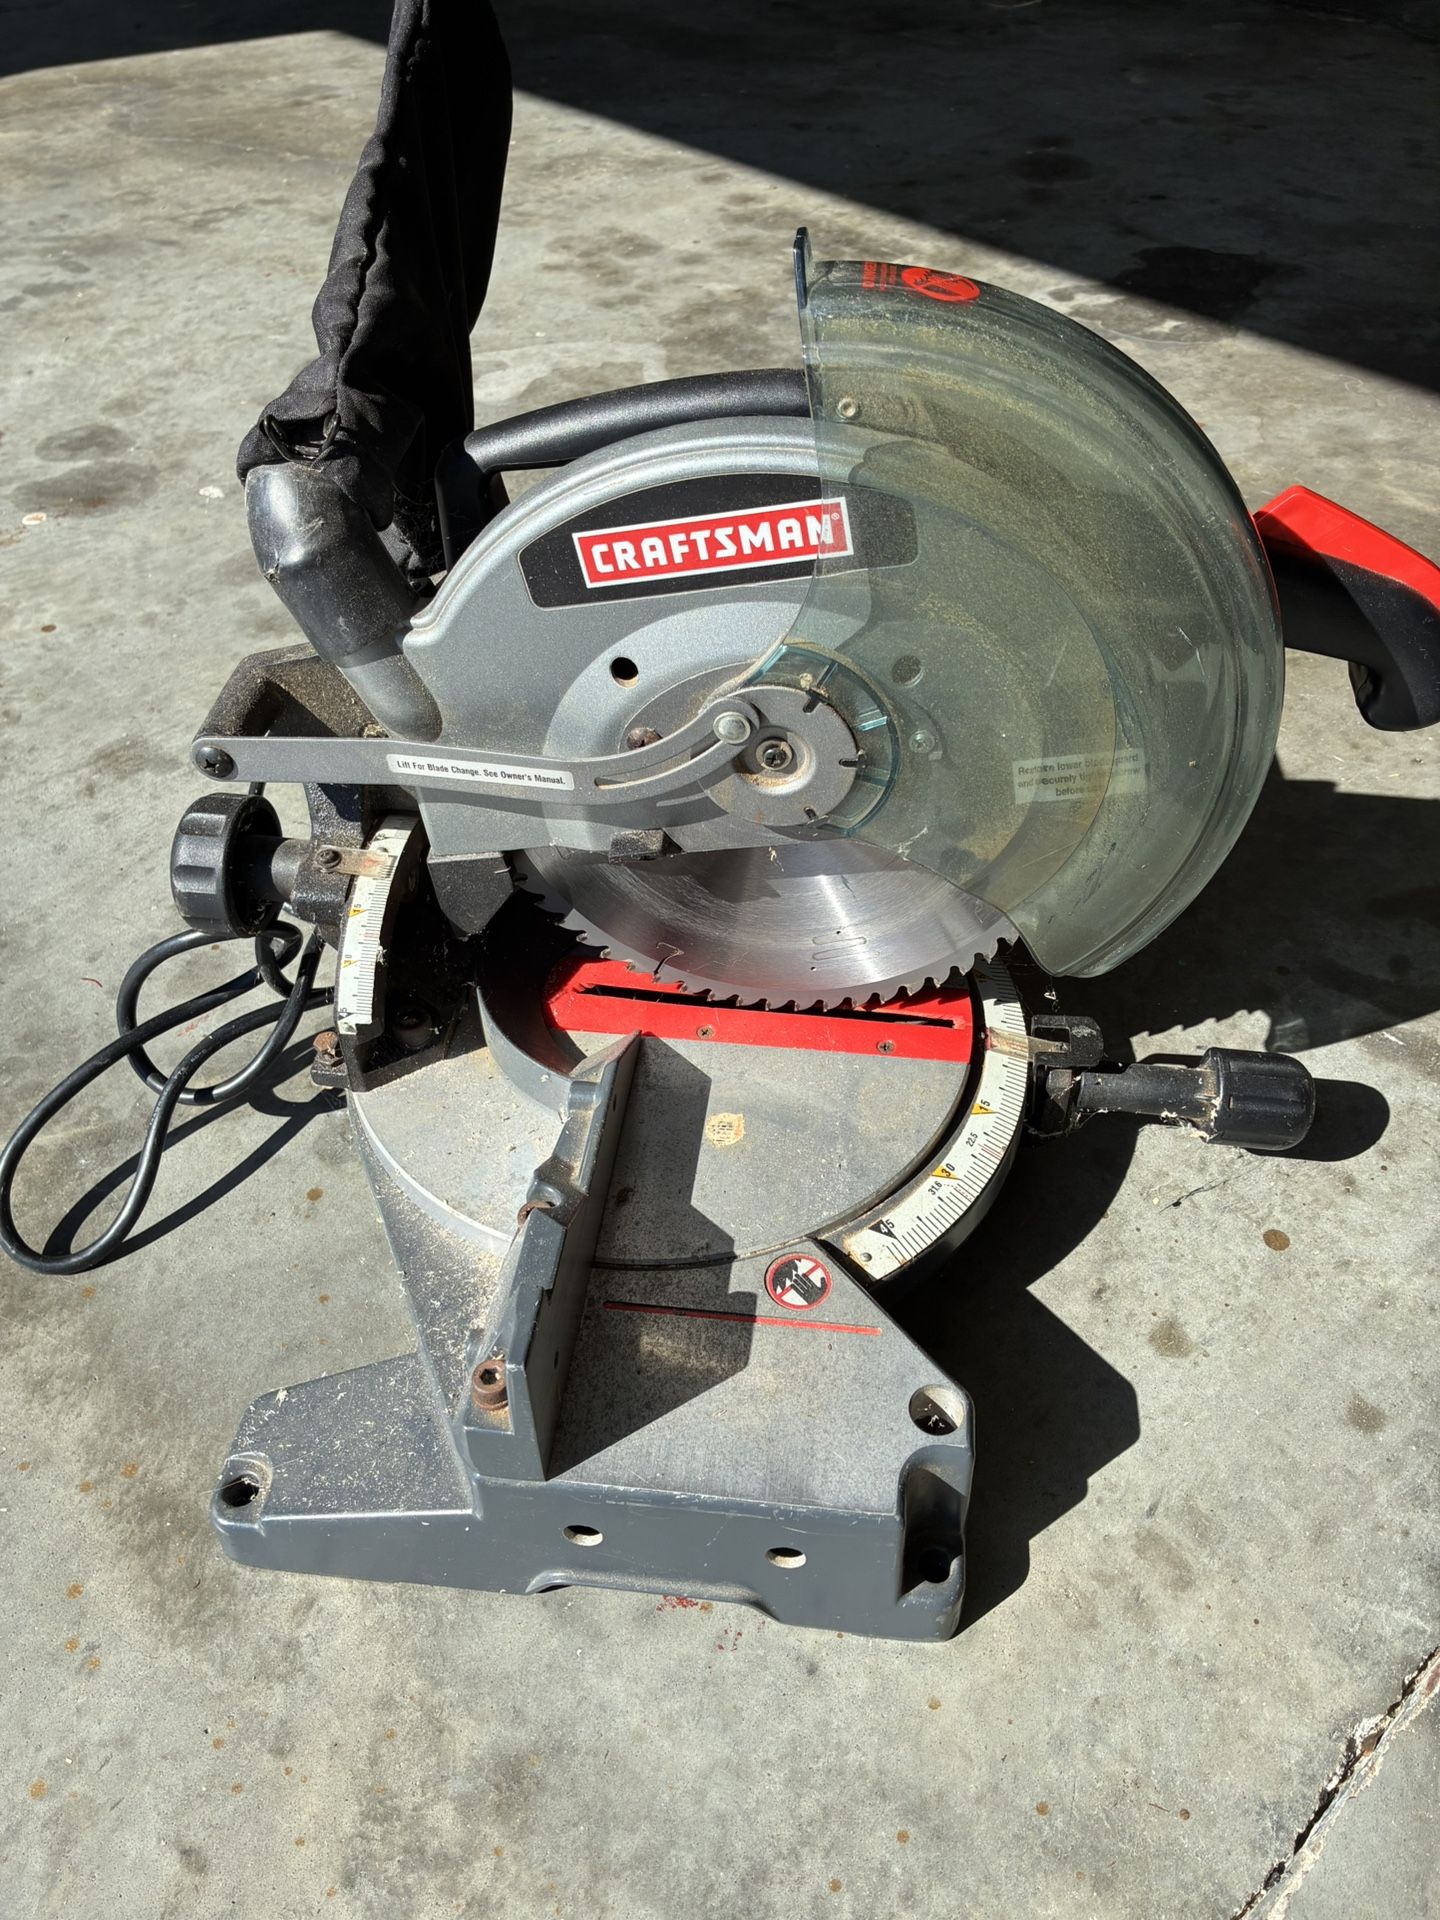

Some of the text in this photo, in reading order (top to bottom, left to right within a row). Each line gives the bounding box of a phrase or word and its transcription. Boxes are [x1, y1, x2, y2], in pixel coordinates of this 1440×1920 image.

[397, 760, 566, 785] Lift For Blade Change. See Owner's Manual.
[1057, 760, 1082, 771] lower
[979, 1099, 991, 1112] 15
[965, 1132, 978, 1147] 22.5
[941, 1163, 955, 1177] 30
[928, 1180, 943, 1196] 31.6
[880, 1219, 895, 1234] 45
